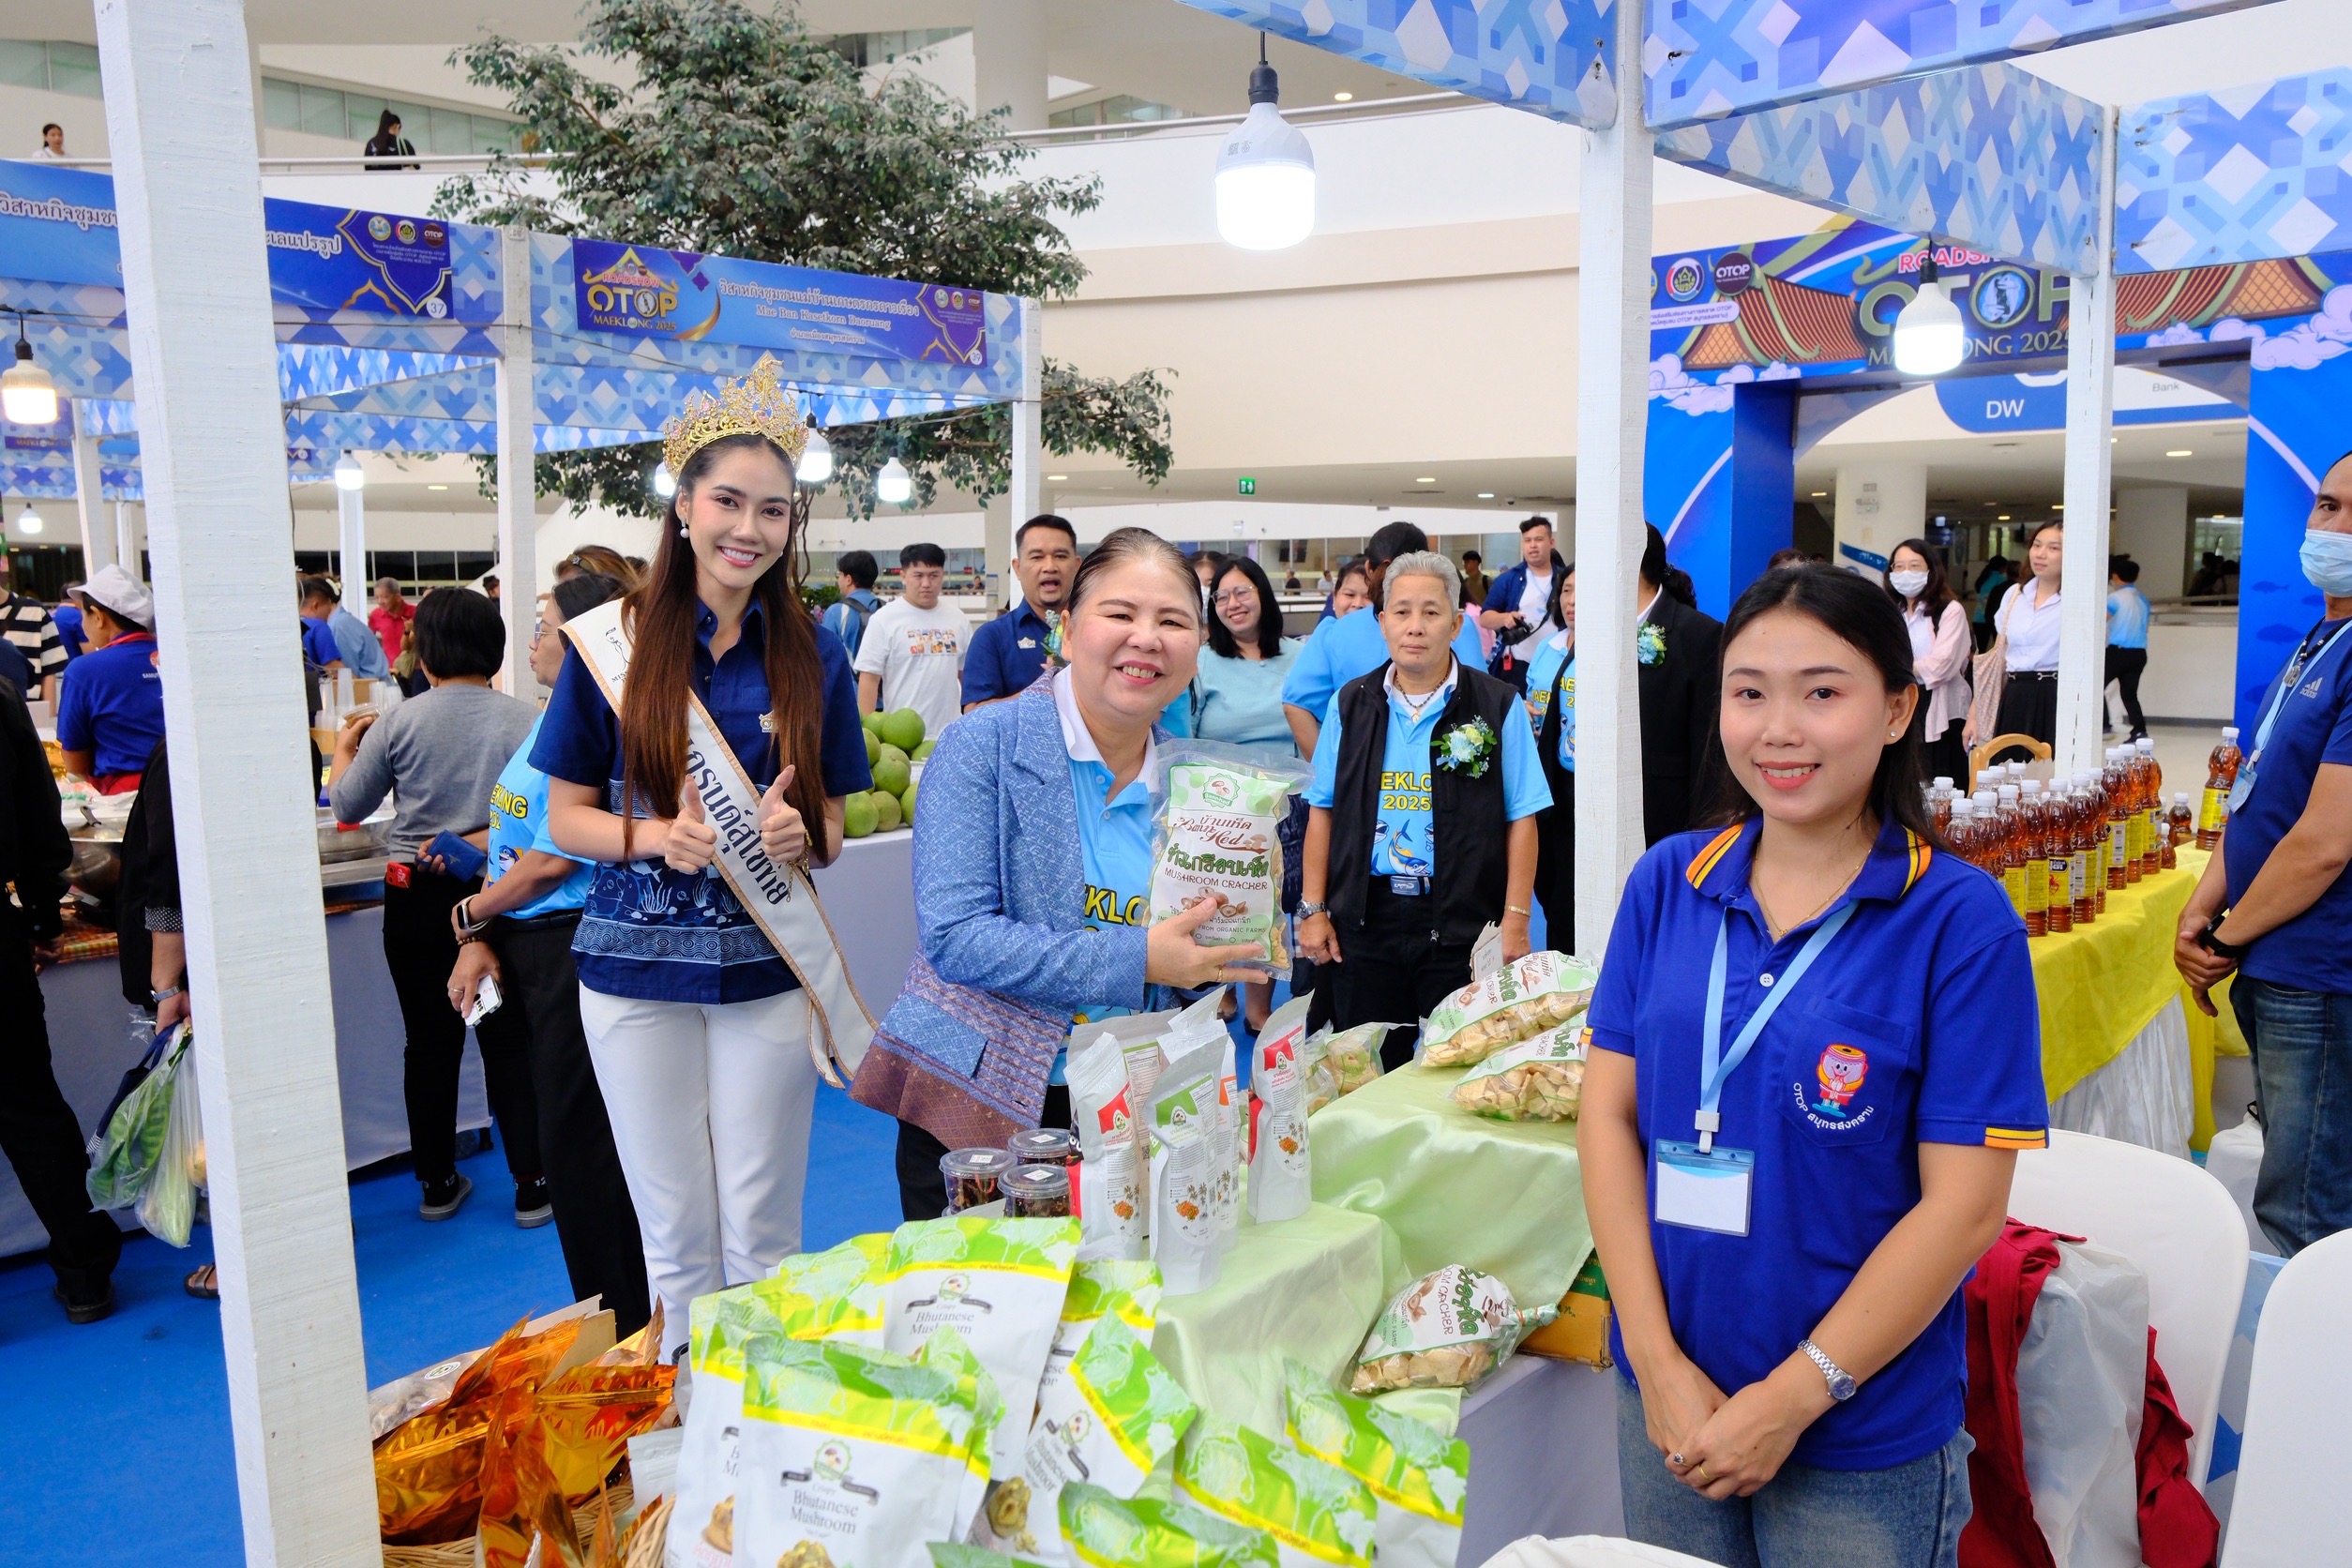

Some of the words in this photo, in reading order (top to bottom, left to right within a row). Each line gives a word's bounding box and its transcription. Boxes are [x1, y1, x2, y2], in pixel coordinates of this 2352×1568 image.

[1715, 264, 1751, 279] OTOP
[602, 273, 659, 288] ROADSHOW
[430, 303, 445, 314] 37
[587, 283, 679, 318] OTOP
[756, 305, 776, 317] Mae
[780, 308, 798, 320] Ban
[849, 314, 891, 330] Daoruang
[656, 321, 676, 331] 2025
[972, 352, 981, 360] 39
[2152, 383, 2179, 392] Bank
[1986, 399, 2025, 419] DW
[1382, 794, 1433, 811] 2025
[1200, 814, 1253, 830] บ้านเห็ด
[1164, 867, 1219, 886] MUSHROOM
[1793, 1082, 1808, 1111] OTOP
[1807, 1105, 1874, 1130] สมุทรสงคราม
[916, 1312, 974, 1323] Bhutanese
[793, 1489, 859, 1517] Bhutanese
[791, 1506, 857, 1535] Mushroom
